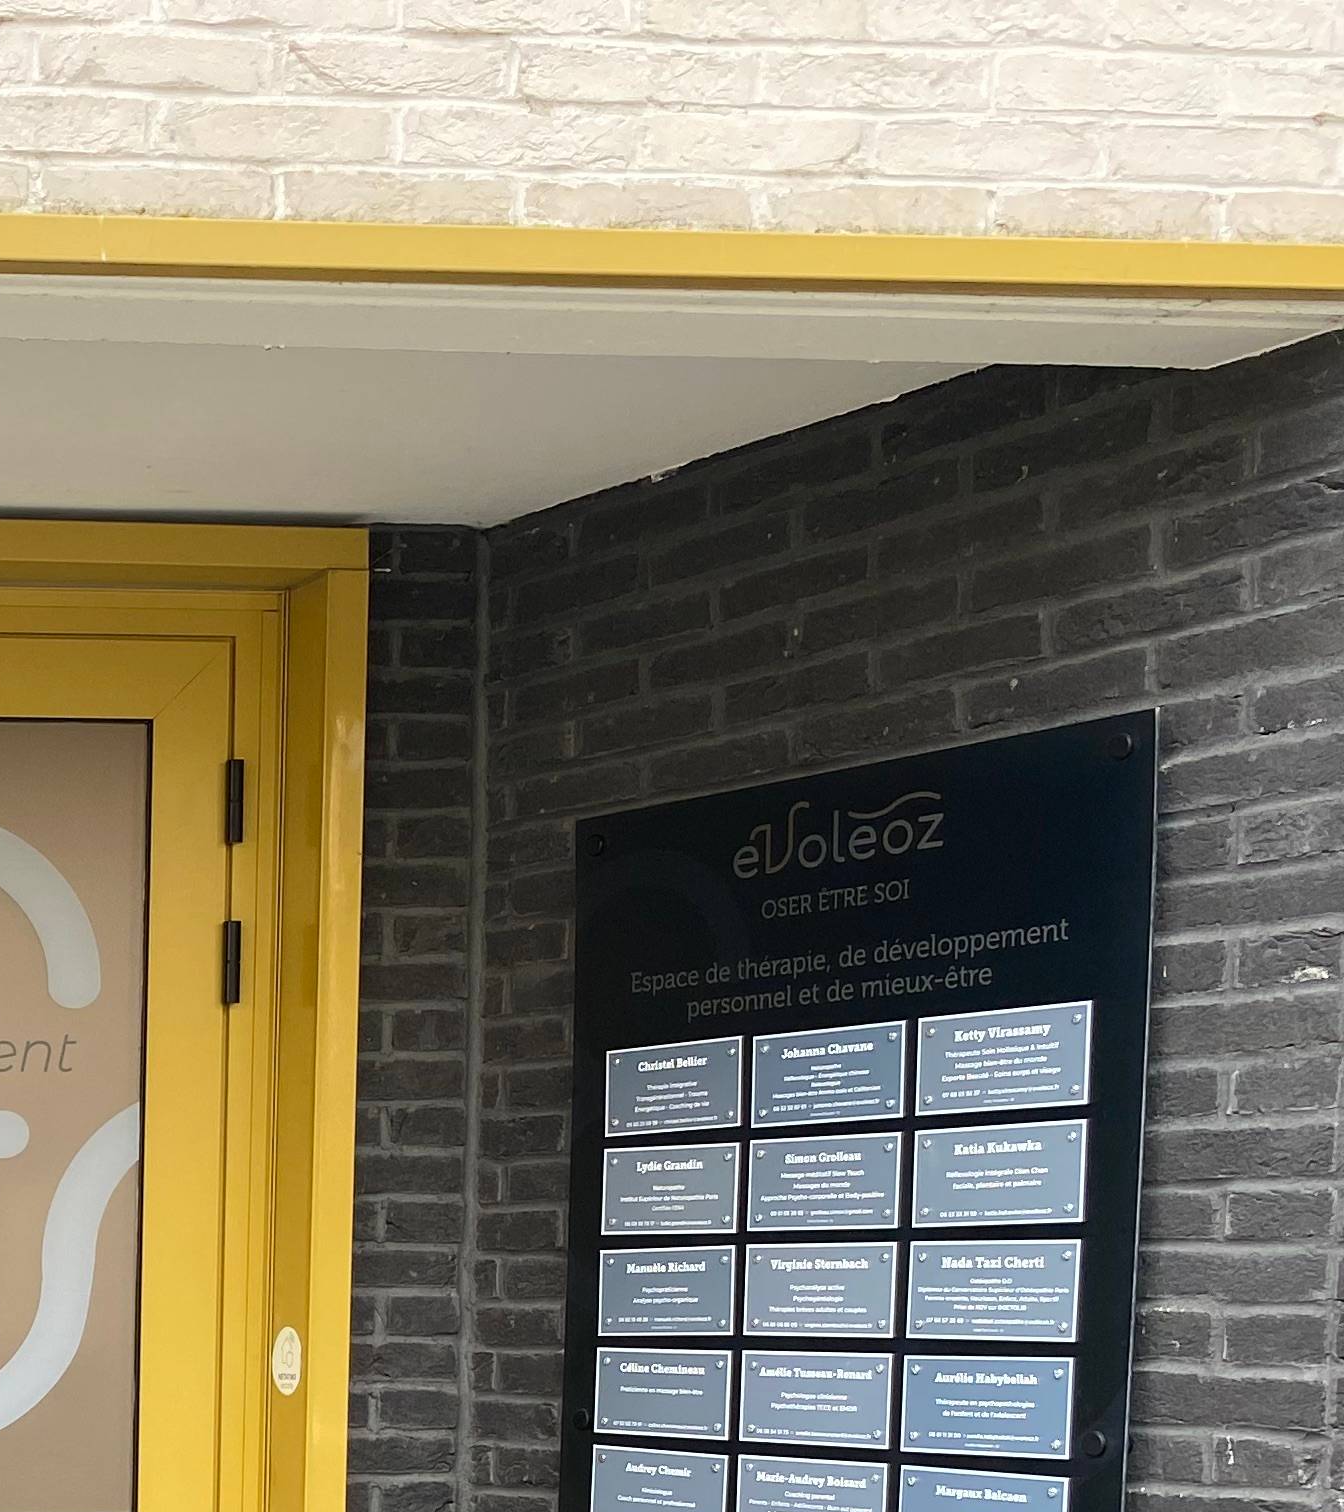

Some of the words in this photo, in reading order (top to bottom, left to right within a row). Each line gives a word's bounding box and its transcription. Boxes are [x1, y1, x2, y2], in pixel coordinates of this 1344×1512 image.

[761, 893, 812, 919] OSER
[817, 884, 868, 913] ÊTRE
[874, 879, 909, 904] SOI
[630, 970, 699, 995] Espace
[705, 962, 732, 986] de
[737, 952, 832, 984] thérapie,
[839, 944, 866, 969] de
[874, 918, 1069, 966] développement
[687, 985, 793, 1023] personnel
[799, 986, 821, 1006] et
[827, 976, 855, 1003] de
[861, 964, 992, 999] mieux-être
[954, 1030, 986, 1043] Ketty
[988, 1024, 1051, 1039] Virassamy
[781, 1047, 825, 1060] Johanna
[638, 1060, 674, 1072] Christel
[676, 1056, 707, 1069] Bellier
[954, 1144, 985, 1156] Katia
[987, 1140, 1042, 1154] Kukawka
[785, 1153, 815, 1164] Simon
[818, 1151, 861, 1163] Grolleau
[636, 1161, 662, 1172] Lydie
[664, 1160, 703, 1171] Grandin
[626, 1262, 666, 1274] Manuèle
[668, 1261, 705, 1272] Richard
[770, 1258, 812, 1272] Virginie
[814, 1258, 868, 1270] Sternbach
[941, 1257, 972, 1269] Nada
[1005, 1256, 1044, 1269] Cherti
[620, 1362, 649, 1374] Céline
[651, 1364, 705, 1375] Chemineau
[760, 1366, 792, 1378] Amélie
[935, 1373, 974, 1383] Aurélie
[625, 1462, 657, 1477] Audrey
[756, 1471, 825, 1488] Marie-Audrey
[936, 1485, 983, 1499] Margaux
